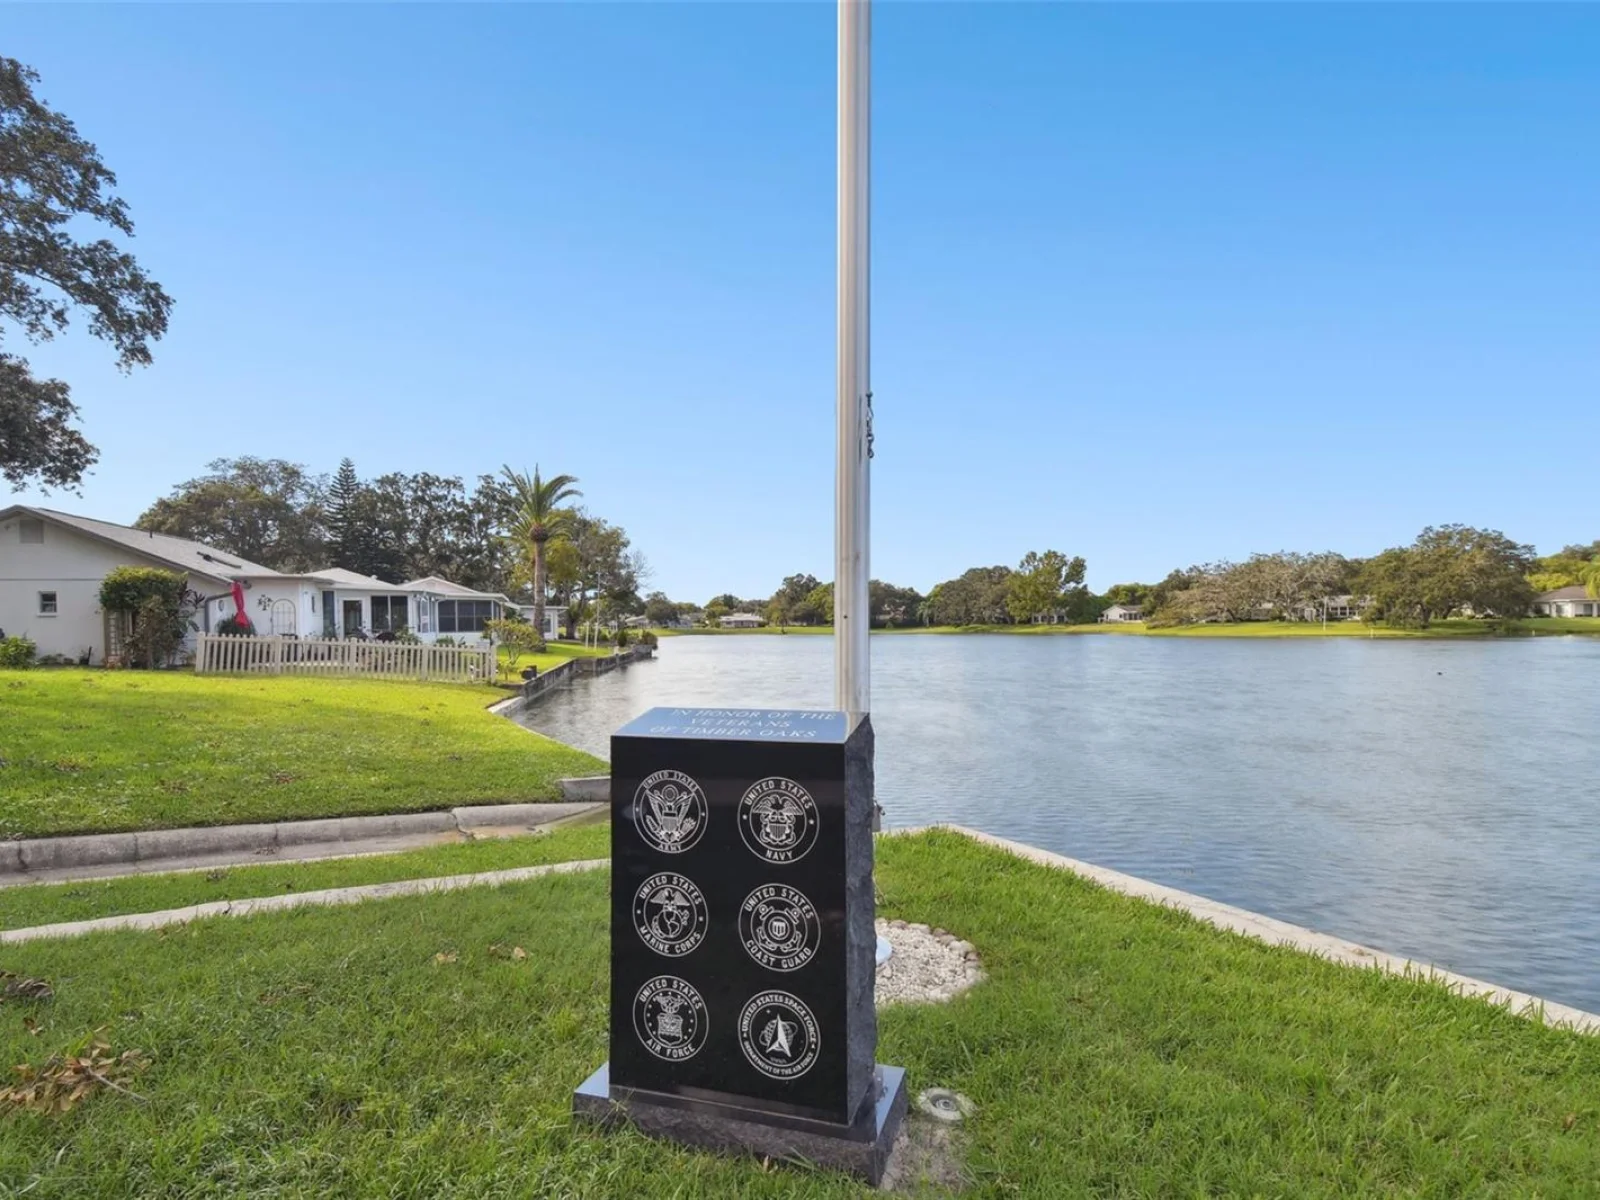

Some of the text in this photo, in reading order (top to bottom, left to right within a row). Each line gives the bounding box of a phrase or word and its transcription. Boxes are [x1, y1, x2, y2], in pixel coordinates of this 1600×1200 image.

[690, 718, 792, 728] VETERANS
[695, 709, 760, 718] HONOR
[800, 712, 836, 720] THE
[650, 726, 678, 735] OF
[682, 727, 752, 736] TIMBER
[643, 771, 699, 792] UNITED STATES
[744, 780, 813, 809] UNITED STATES
[766, 849, 793, 861] NAVY
[639, 876, 702, 905] UNITED STATES
[744, 887, 814, 919] UNITED STATES
[640, 925, 701, 954] MARINE CORPS
[746, 939, 812, 969] COAST GUARD
[639, 979, 702, 1010] UNITED STATES
[742, 994, 817, 1045] UNITED STATES SPACE FORCE
[646, 1038, 696, 1058] AIR FORCE
